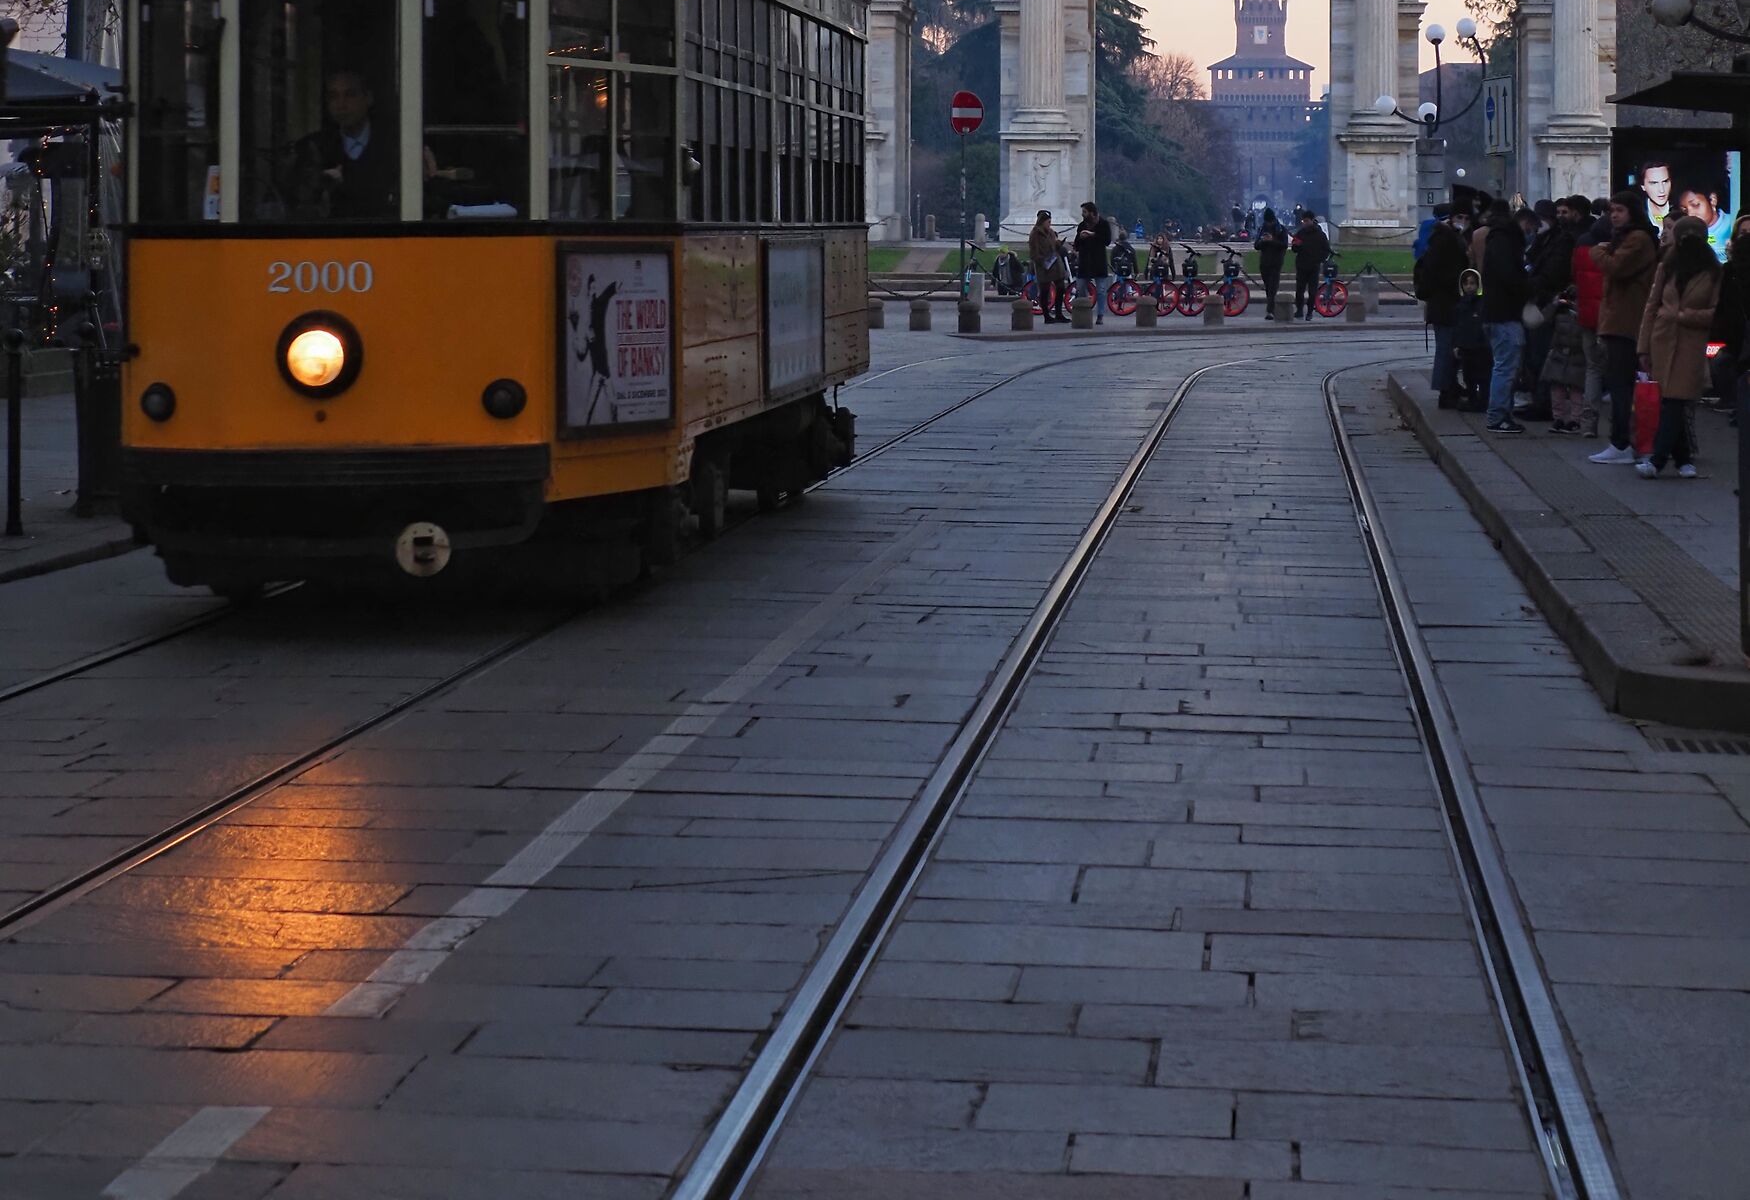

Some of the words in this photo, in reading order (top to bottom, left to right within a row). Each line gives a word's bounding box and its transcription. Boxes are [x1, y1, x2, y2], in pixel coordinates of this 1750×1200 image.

[268, 260, 374, 293] 2000
[616, 299, 633, 331] THE
[636, 298, 666, 330] WORLD
[617, 346, 628, 378] OF
[631, 345, 666, 377] BANKSY
